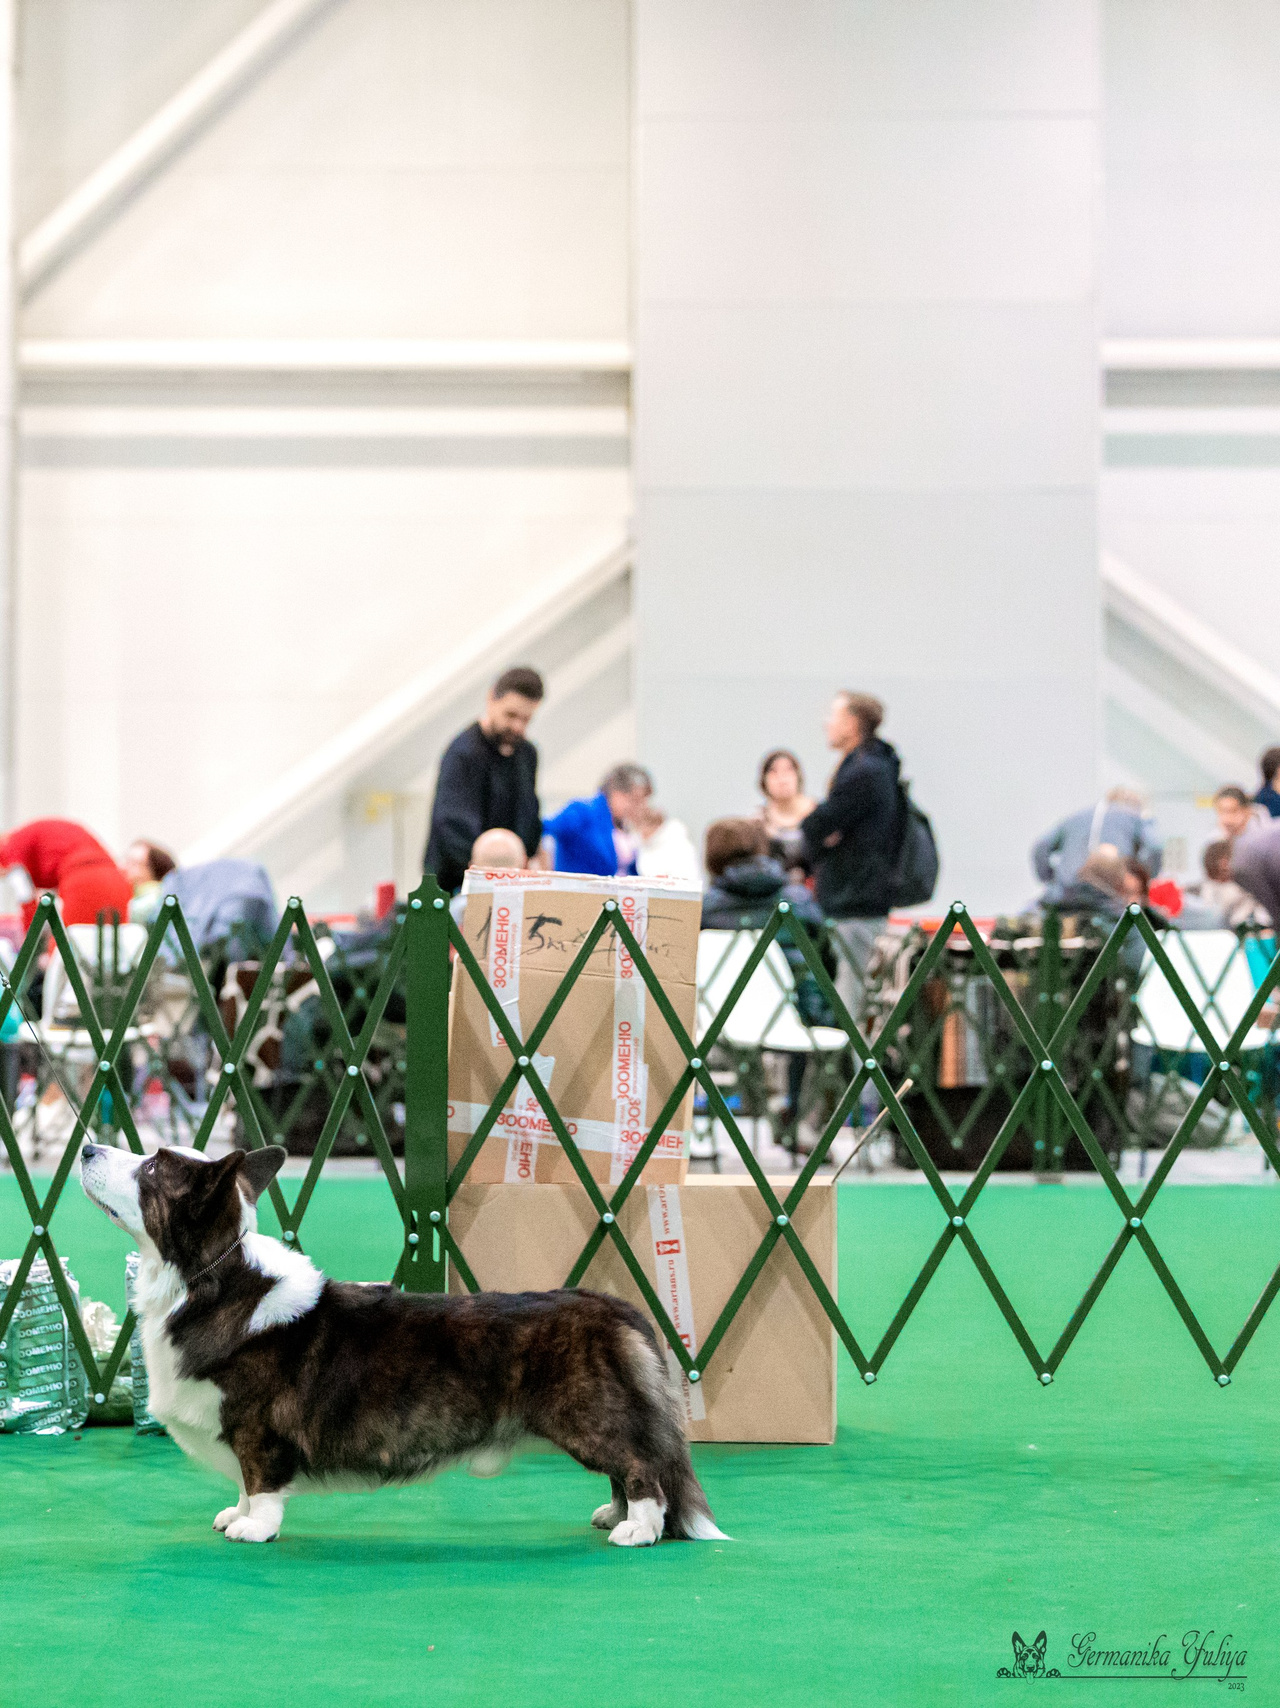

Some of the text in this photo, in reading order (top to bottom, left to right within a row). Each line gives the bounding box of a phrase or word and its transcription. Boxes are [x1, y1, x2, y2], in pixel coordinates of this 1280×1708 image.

[494, 907, 510, 988] ЗООМЕНЮ
[496, 1112, 578, 1135] ЗООМЕЮ
[668, 1259, 680, 1329] www.artans.ru
[20, 1323, 62, 1338] ООМЕНЮ
[20, 1342, 63, 1358] ООМЕНЮ
[20, 1362, 63, 1377] ООМЕНЮ
[19, 1381, 63, 1397] ООМЕНЮ
